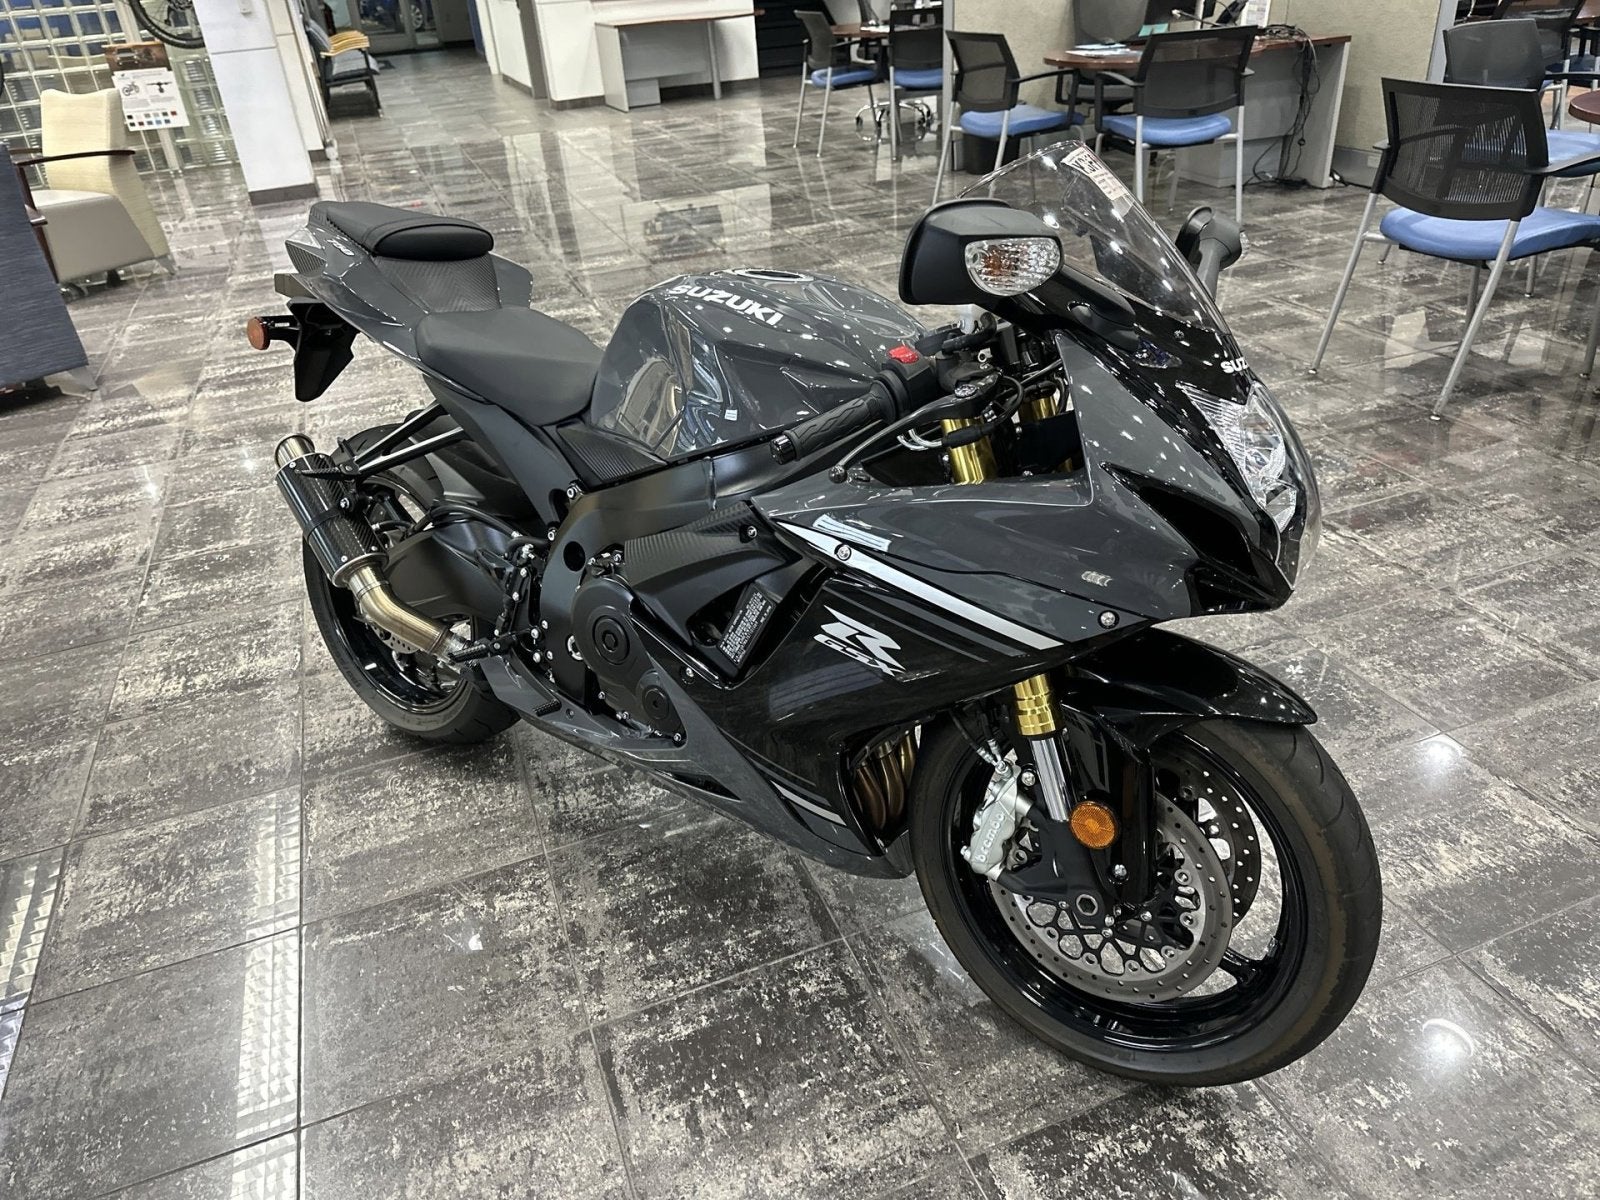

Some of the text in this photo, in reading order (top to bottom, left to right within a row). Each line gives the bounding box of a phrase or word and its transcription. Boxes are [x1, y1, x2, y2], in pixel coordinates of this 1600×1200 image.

[668, 285, 784, 326] SUZUKI
[813, 633, 905, 677] GSX
[974, 813, 1005, 862] brembo
